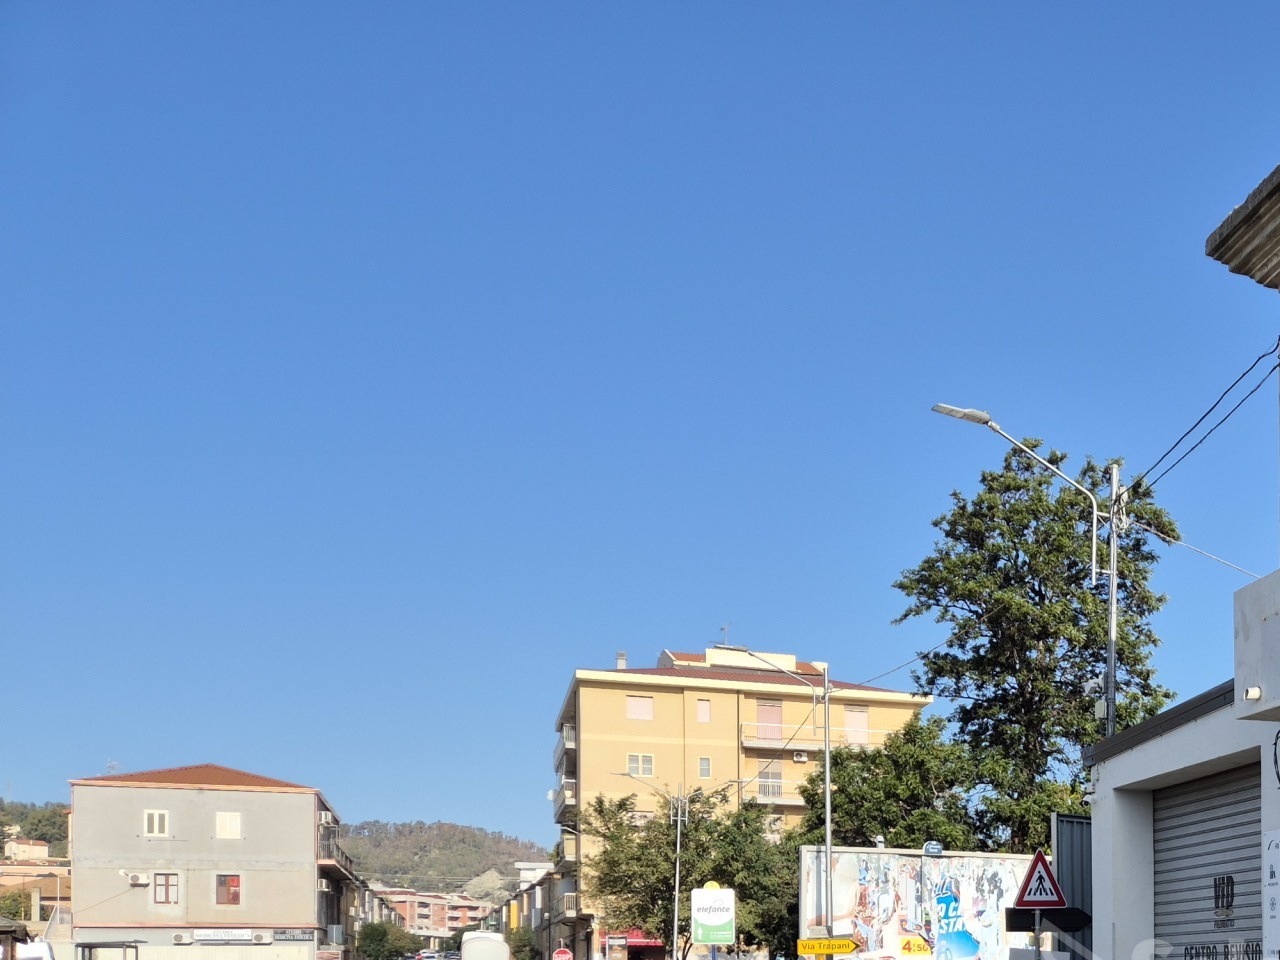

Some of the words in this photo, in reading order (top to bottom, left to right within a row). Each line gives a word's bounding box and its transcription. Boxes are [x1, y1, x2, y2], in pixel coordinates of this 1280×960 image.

[696, 906, 731, 914] elefante
[801, 942, 815, 950] Via
[818, 942, 850, 951] Trapani
[554, 953, 571, 960] STOP
